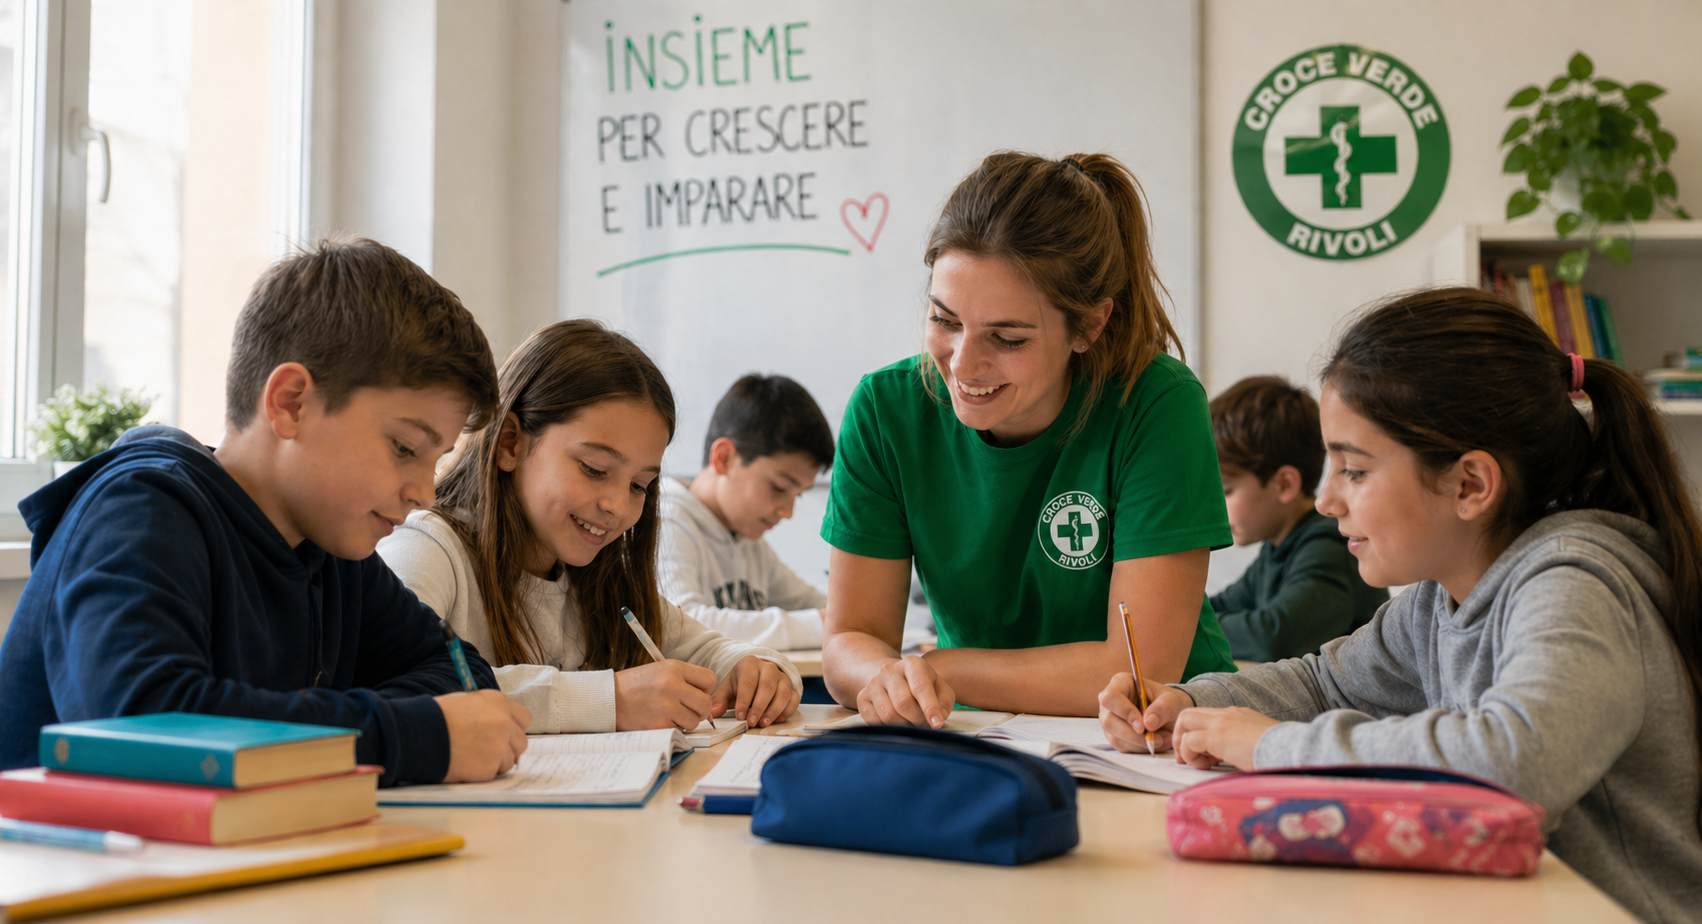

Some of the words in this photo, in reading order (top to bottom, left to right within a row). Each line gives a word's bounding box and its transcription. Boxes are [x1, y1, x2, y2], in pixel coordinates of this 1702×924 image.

[1244, 51, 1337, 131] CROCE
[1348, 52, 1439, 130] VERDE
[598, 112, 665, 163] PER
[685, 99, 868, 157] CRESCERE
[602, 185, 623, 234] E
[645, 172, 818, 228] IMPARARE
[1287, 219, 1398, 256] RIVOLI
[1042, 494, 1073, 523] CROCE
[1077, 494, 1105, 520] VERDE
[1058, 553, 1097, 567] RIVOLI
